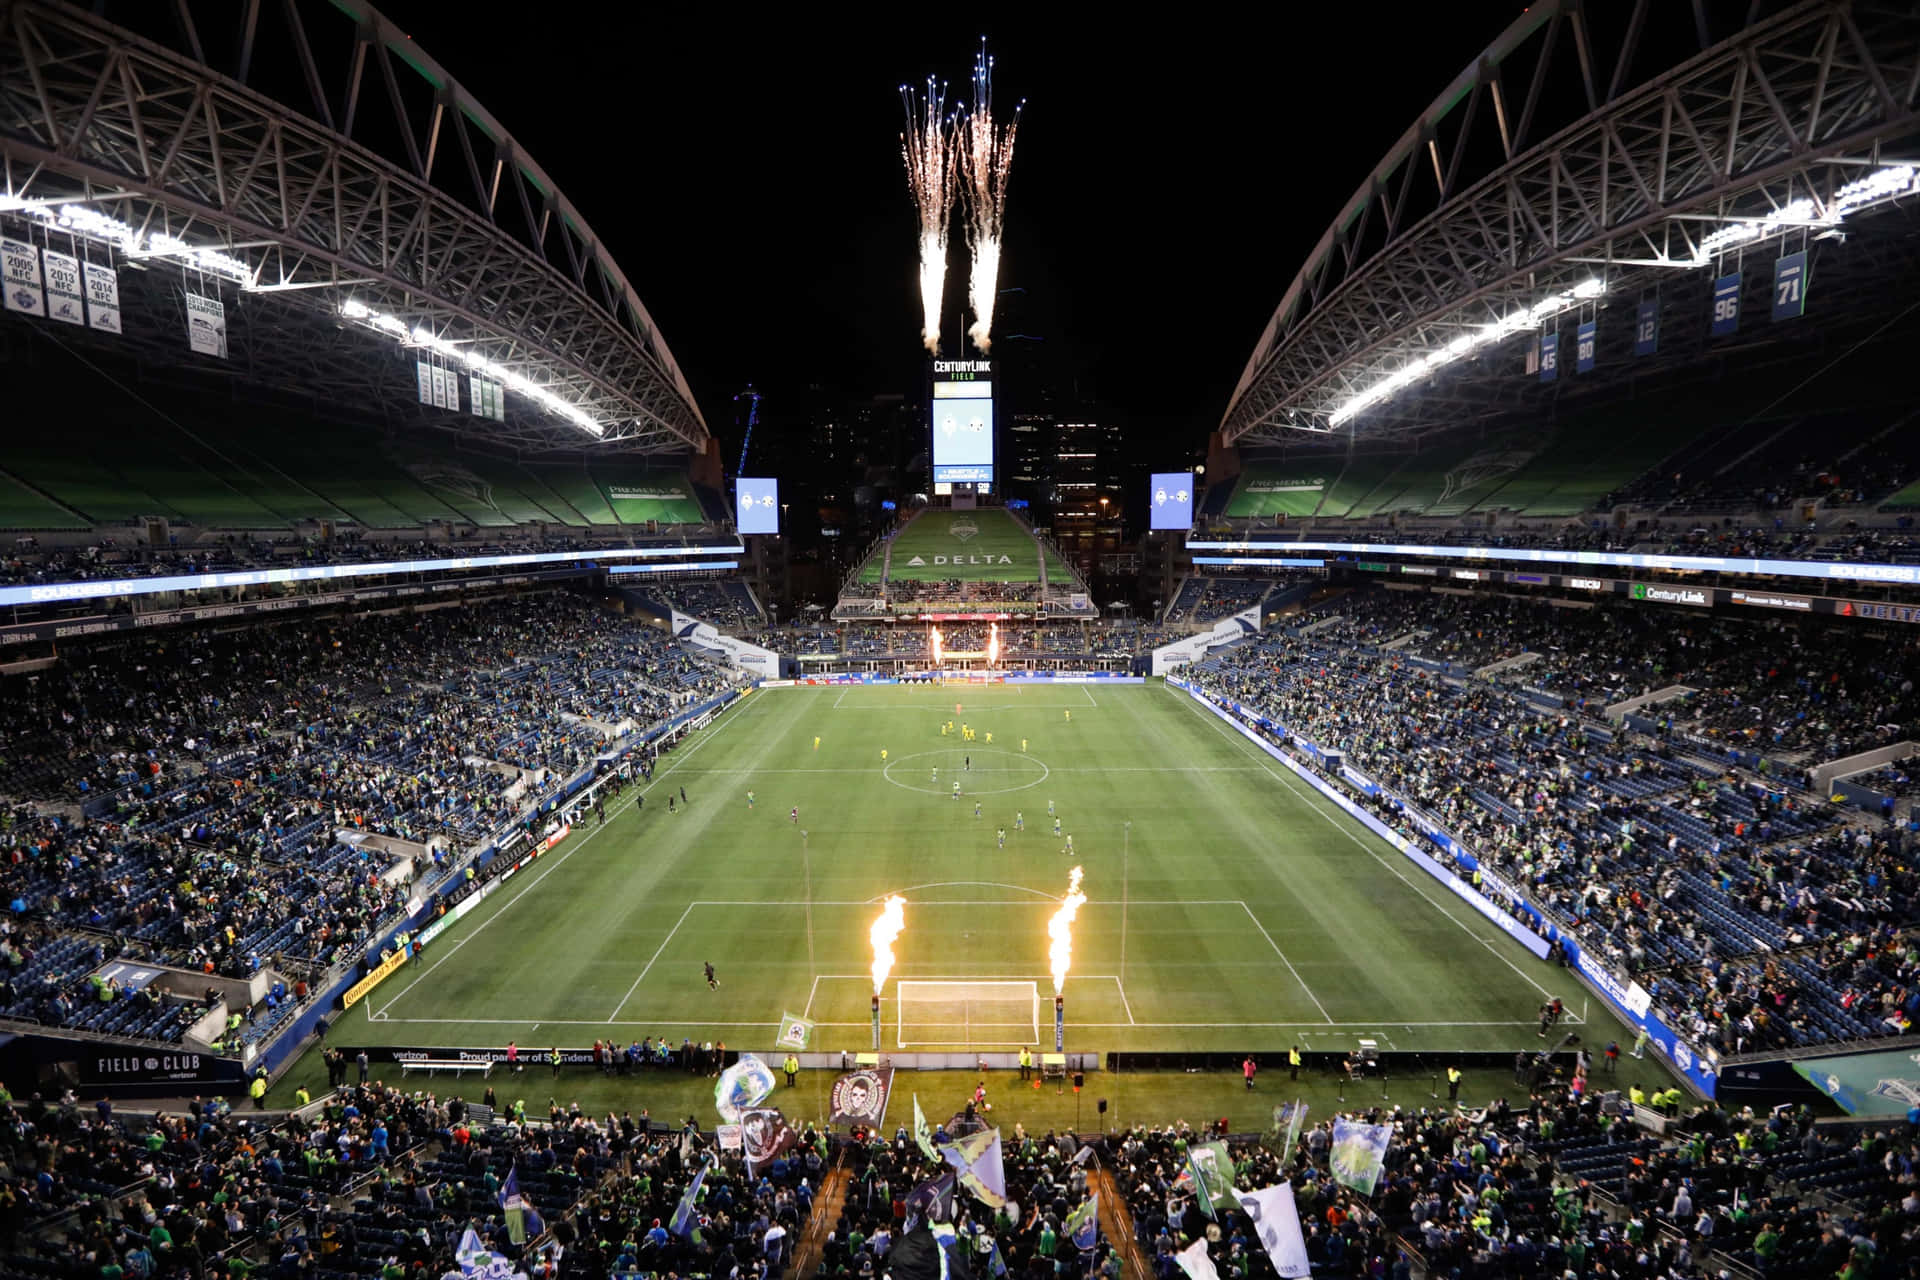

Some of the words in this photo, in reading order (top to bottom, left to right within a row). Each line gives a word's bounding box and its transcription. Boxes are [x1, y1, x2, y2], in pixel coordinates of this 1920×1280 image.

[8, 255, 34, 272] 2005
[12, 268, 31, 281] NFC
[50, 268, 75, 284] 2013
[55, 281, 73, 292] NFC
[90, 279, 113, 294] 2014
[1778, 278, 1800, 306] 71
[95, 291, 111, 303] NFC
[1715, 297, 1738, 322] 96
[1639, 321, 1655, 343] 12
[1578, 341, 1593, 360] 80
[1541, 351, 1556, 371] 45
[951, 372, 975, 380] FIELD
[934, 555, 1013, 565] DELTA
[1829, 566, 1914, 579] SOUNDERS
[32, 583, 112, 600] SOUNDERS
[115, 582, 134, 593] FC
[1647, 587, 1705, 604] CenturyLink
[392, 1051, 429, 1060] verizon
[460, 1051, 490, 1061] Proud
[531, 1052, 542, 1062] of
[98, 1057, 140, 1073] FIELD
[163, 1055, 200, 1070] CLUB
